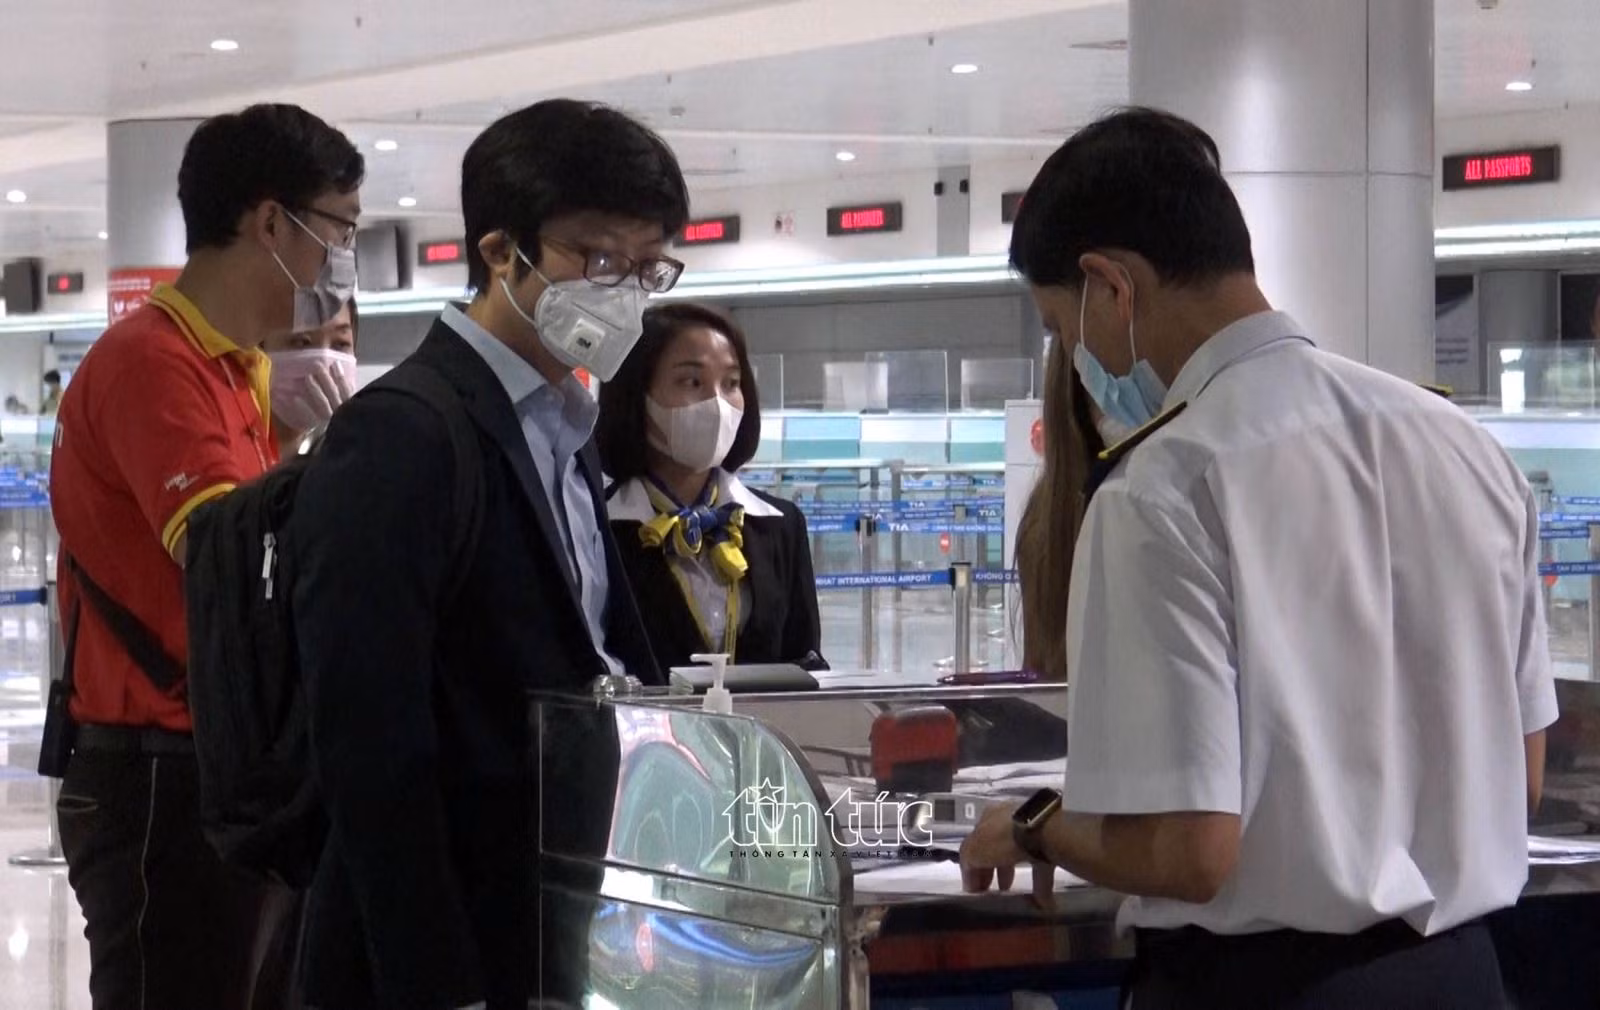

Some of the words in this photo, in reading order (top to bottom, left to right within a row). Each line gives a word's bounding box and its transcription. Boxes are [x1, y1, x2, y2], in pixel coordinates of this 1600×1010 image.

[1465, 159, 1482, 180] ALL
[1484, 156, 1532, 178] PASSPORTS
[978, 509, 997, 517] TIA
[888, 523, 909, 531] TIA
[838, 575, 896, 585] INTERNATIONAL
[898, 573, 932, 583] AIRPORT
